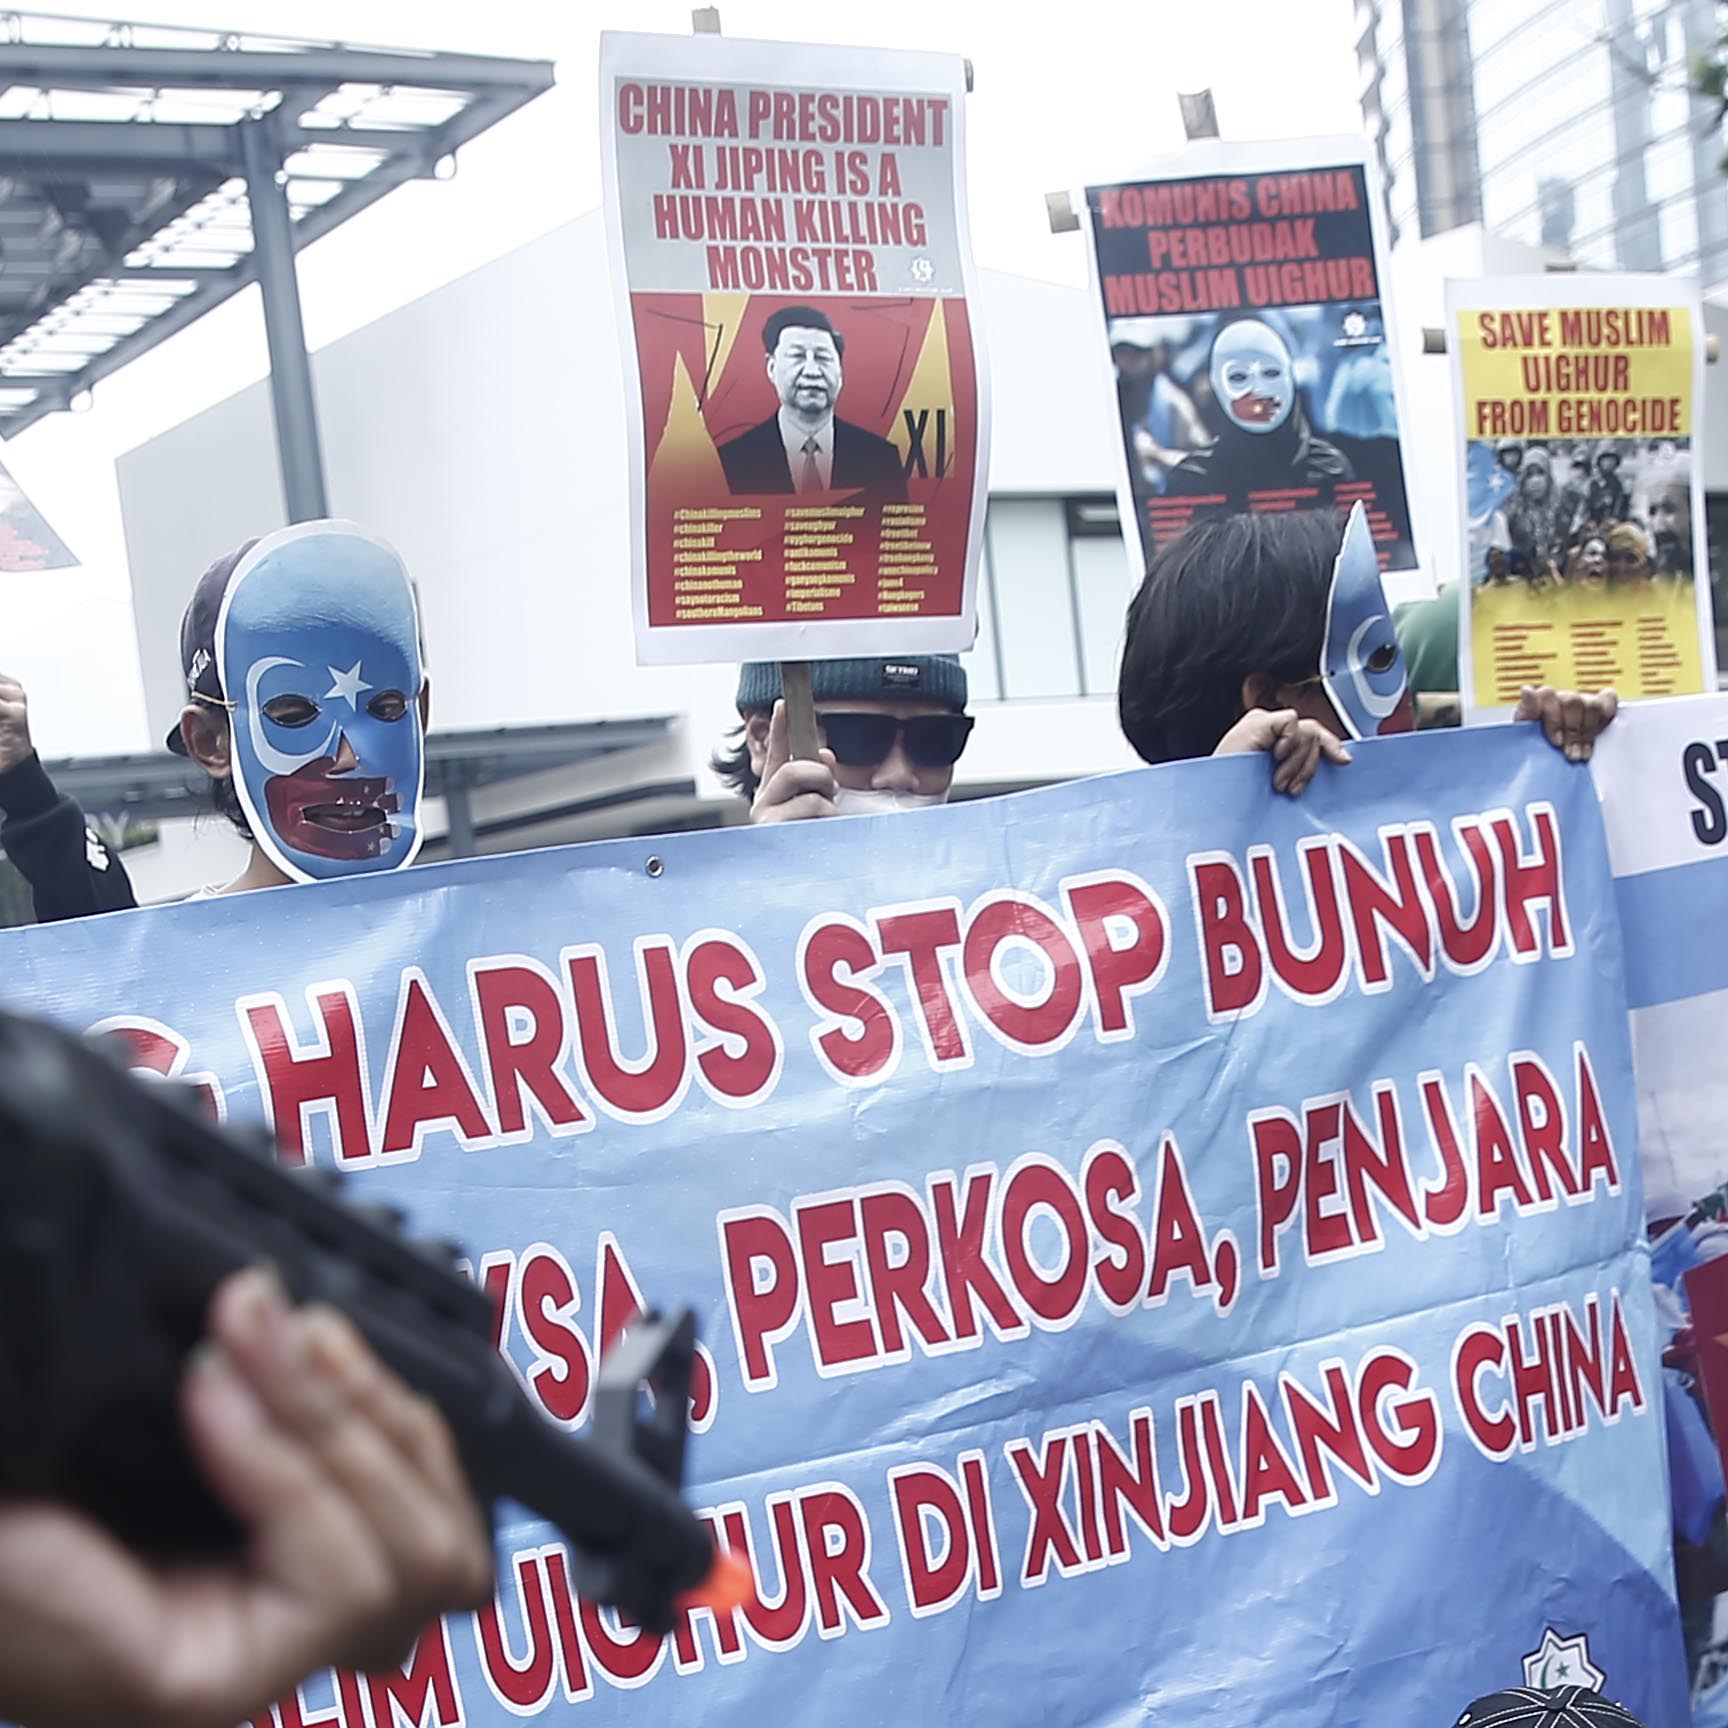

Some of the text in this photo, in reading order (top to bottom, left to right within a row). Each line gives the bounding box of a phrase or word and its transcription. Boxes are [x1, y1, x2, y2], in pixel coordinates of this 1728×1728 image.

[619, 83, 948, 147] CHINA PRESIDENT
[669, 143, 901, 197] XI JIPING IS A
[653, 195, 926, 247] HUMAN KILLING
[1098, 170, 1358, 229] KOMUNIS CHINA
[706, 246, 878, 292] MONSTER
[1148, 219, 1319, 269] PERBUDAK
[1104, 257, 1375, 316] MUSLIM UIGHUR
[1480, 309, 1670, 349] SAVE MUSLIM
[1522, 355, 1630, 392] UIGHUR
[902, 408, 946, 479] XI
[1476, 398, 1681, 435] FROM GENOCIDE
[242, 936, 782, 1162] HARUS
[803, 877, 1164, 1080] STOP
[1190, 806, 1570, 1016] BUNUH
[722, 1140, 1238, 1383] PERKOSA,
[1250, 1048, 1622, 1274] PENJARA
[892, 1458, 1003, 1611] DI
[1022, 1351, 1440, 1584] XINJIANG
[1454, 1291, 1643, 1455] CHINA
